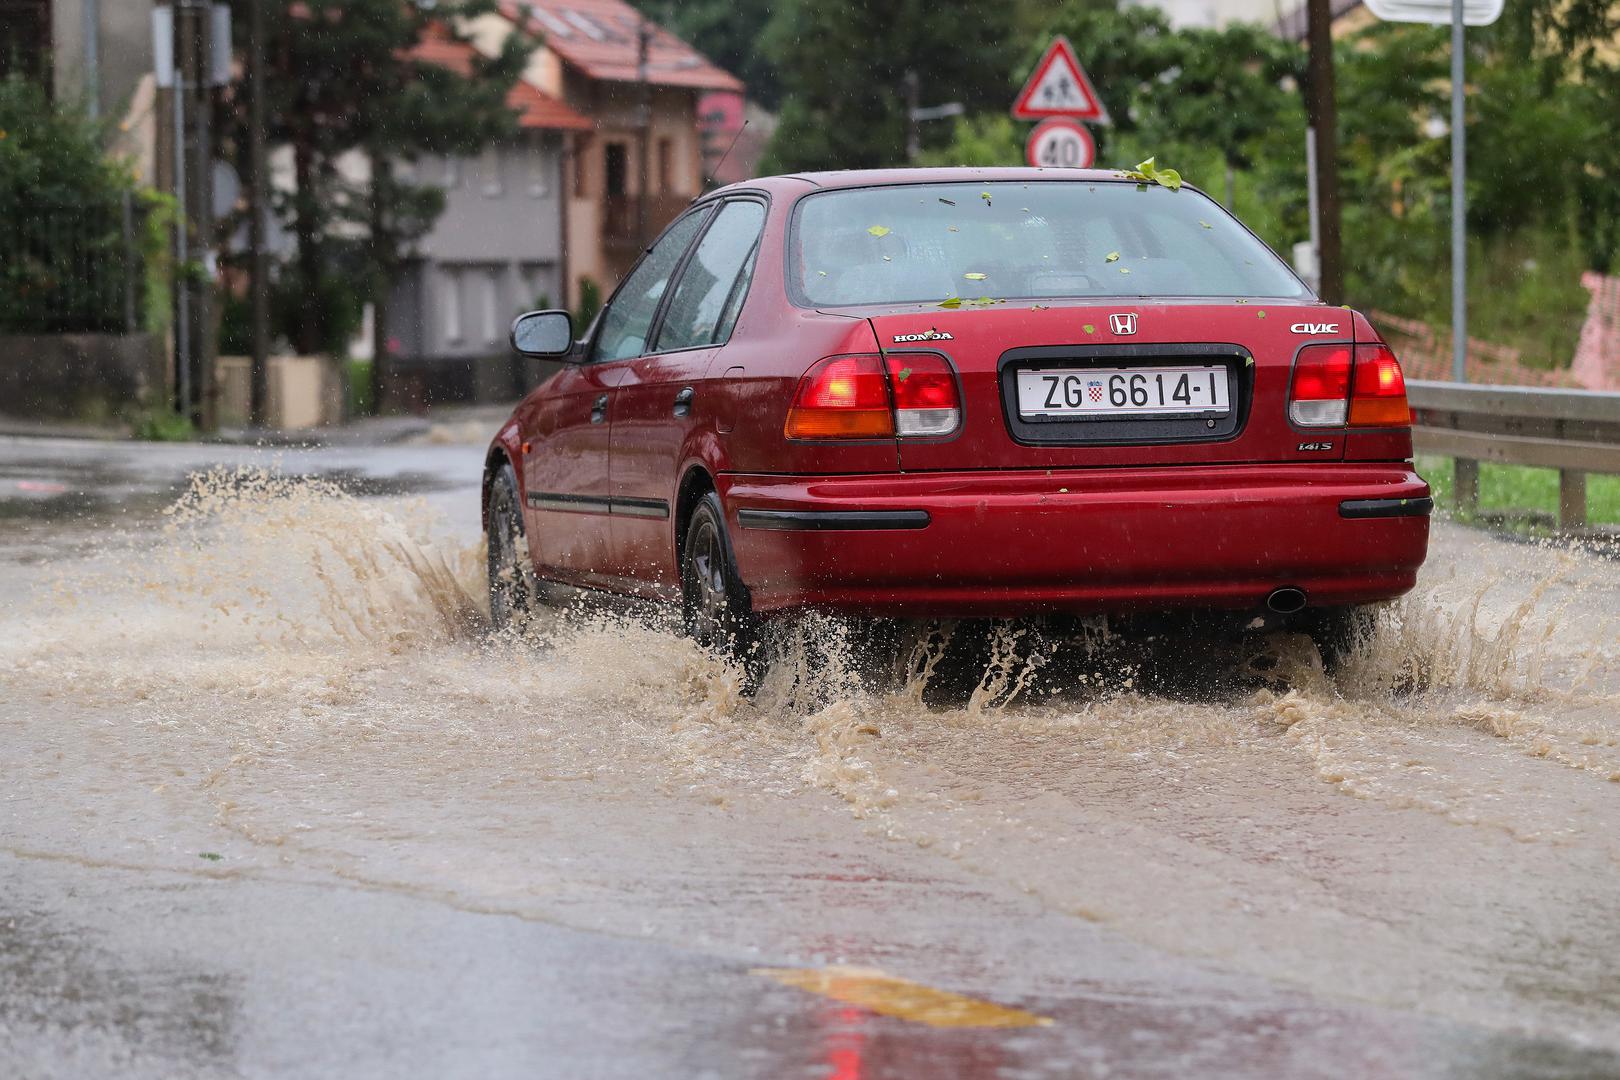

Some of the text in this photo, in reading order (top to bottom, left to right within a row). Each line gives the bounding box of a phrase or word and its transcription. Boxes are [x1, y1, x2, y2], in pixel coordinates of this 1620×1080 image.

[1042, 137, 1080, 164] 40
[893, 332, 954, 342] HONDA
[1290, 323, 1339, 334] CIVIC
[1042, 375, 1083, 408] ZG
